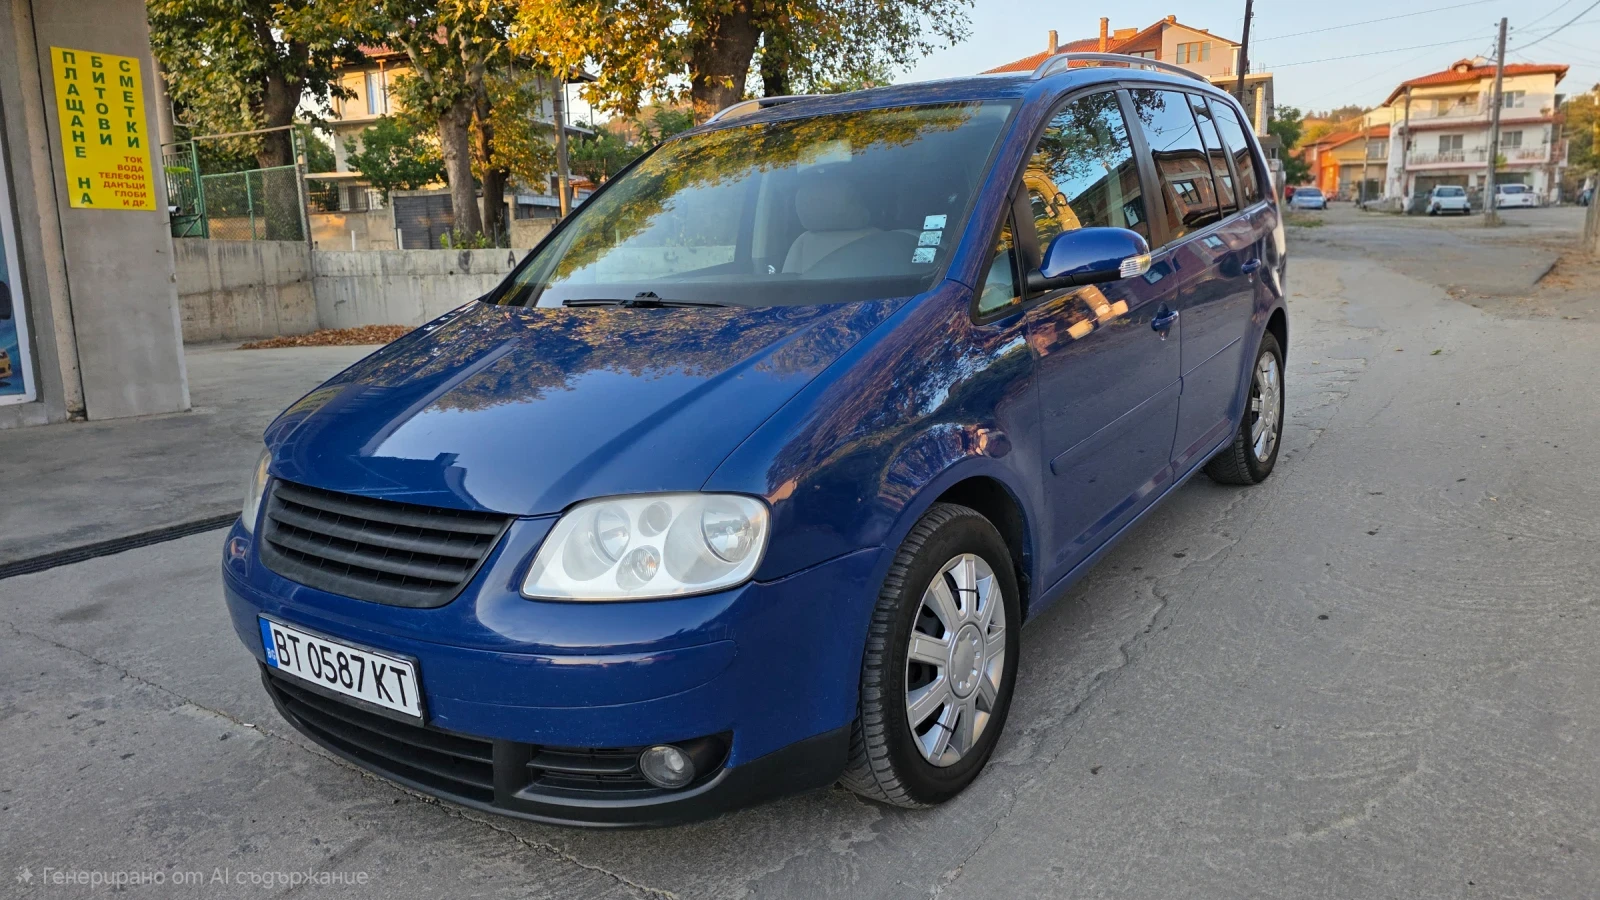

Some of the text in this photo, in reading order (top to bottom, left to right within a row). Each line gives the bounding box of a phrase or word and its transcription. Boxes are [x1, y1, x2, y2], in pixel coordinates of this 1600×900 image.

[91, 56, 112, 146] БИТОВИ
[118, 60, 139, 148] СМЕТКИ
[62, 52, 93, 204] ПЛАЩАНЕ НА
[124, 156, 143, 164] ТОК
[117, 164, 144, 173] ВОДА
[98, 172, 145, 181] ТЕЛЕФОН
[103, 181, 146, 190] ДАНЪЦИ
[114, 190, 147, 198] ГЛОБИ
[132, 199, 148, 207] ДР.
[307, 642, 365, 692] 0587
